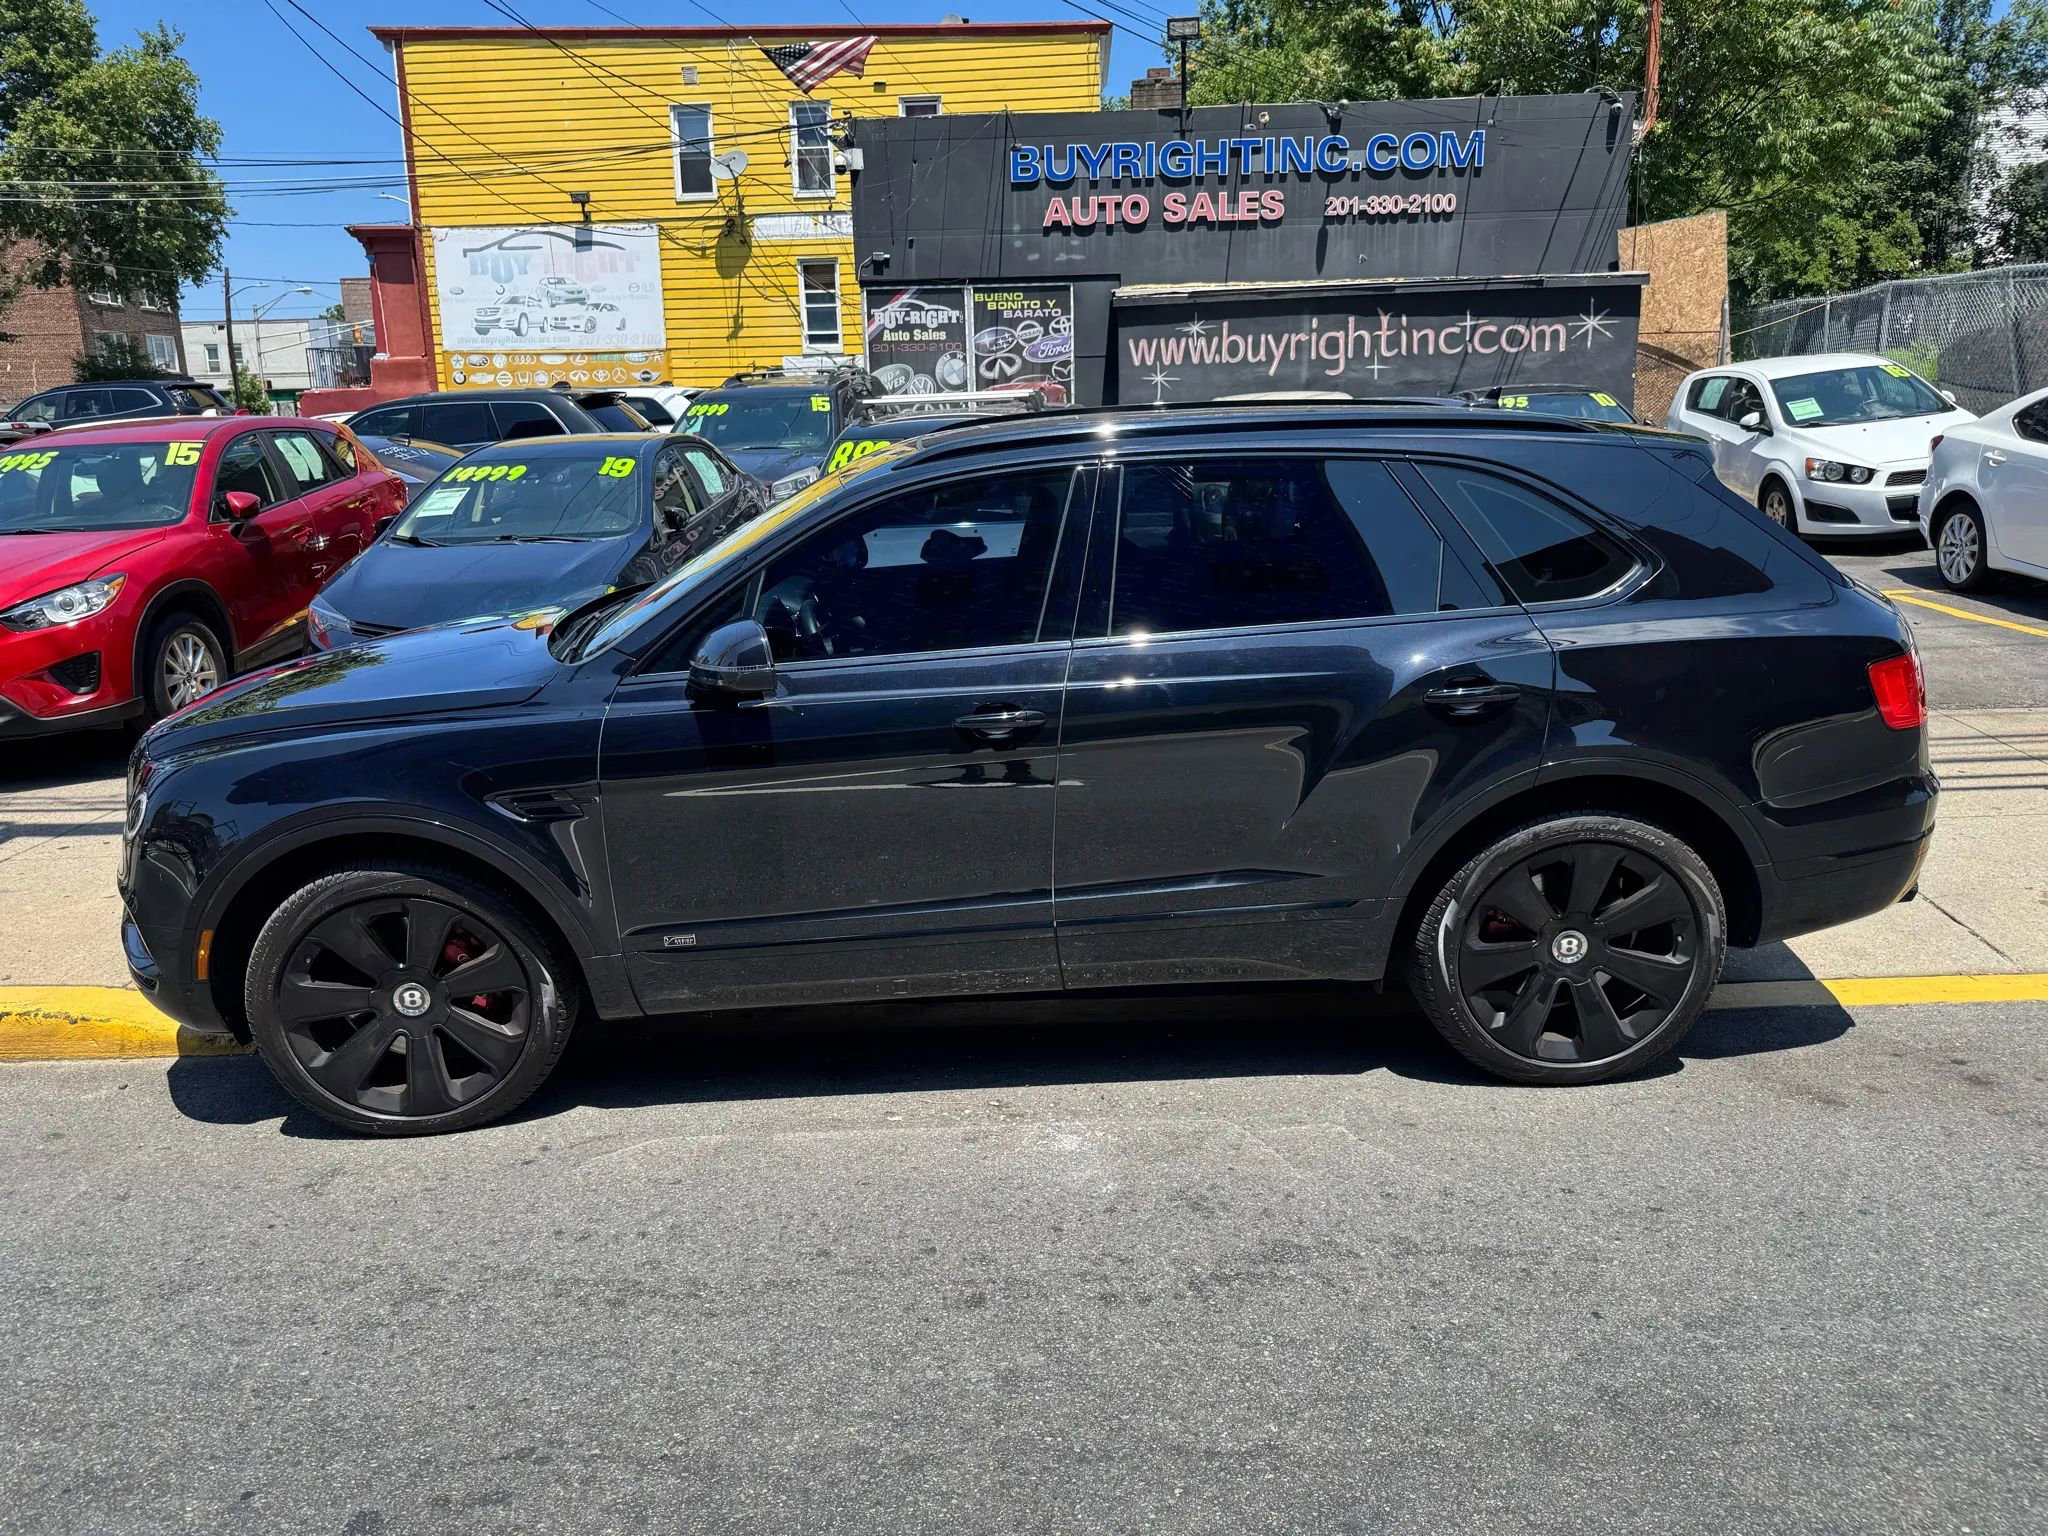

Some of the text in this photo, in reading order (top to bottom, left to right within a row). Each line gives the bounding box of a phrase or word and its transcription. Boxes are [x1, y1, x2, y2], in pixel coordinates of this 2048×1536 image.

[1010, 129, 1486, 183] BUYRIGHTINC.COM
[1042, 189, 1285, 227] AUTO SALES
[1325, 193, 1457, 217] 201-330-2100
[974, 292, 1023, 302] BUENO
[987, 299, 1057, 310] BONITO Y
[874, 309, 960, 329] BUY-RIGHT
[1003, 308, 1062, 318] BARATO
[882, 328, 947, 342] Auto Sales
[872, 342, 963, 353] 201-330-2100
[1038, 339, 1071, 358] Ford
[1128, 314, 1567, 377] www.buyrightinc.com
[810, 396, 831, 412] 15
[1498, 396, 1529, 408] 95
[1589, 393, 1617, 407] 10
[686, 403, 730, 417] 8999
[164, 442, 204, 466] 15
[442, 464, 527, 483] 14999
[598, 456, 637, 478] 19
[1625, 828, 1665, 846] ZERO
[1559, 937, 1579, 955] B
[402, 990, 423, 1007] B
